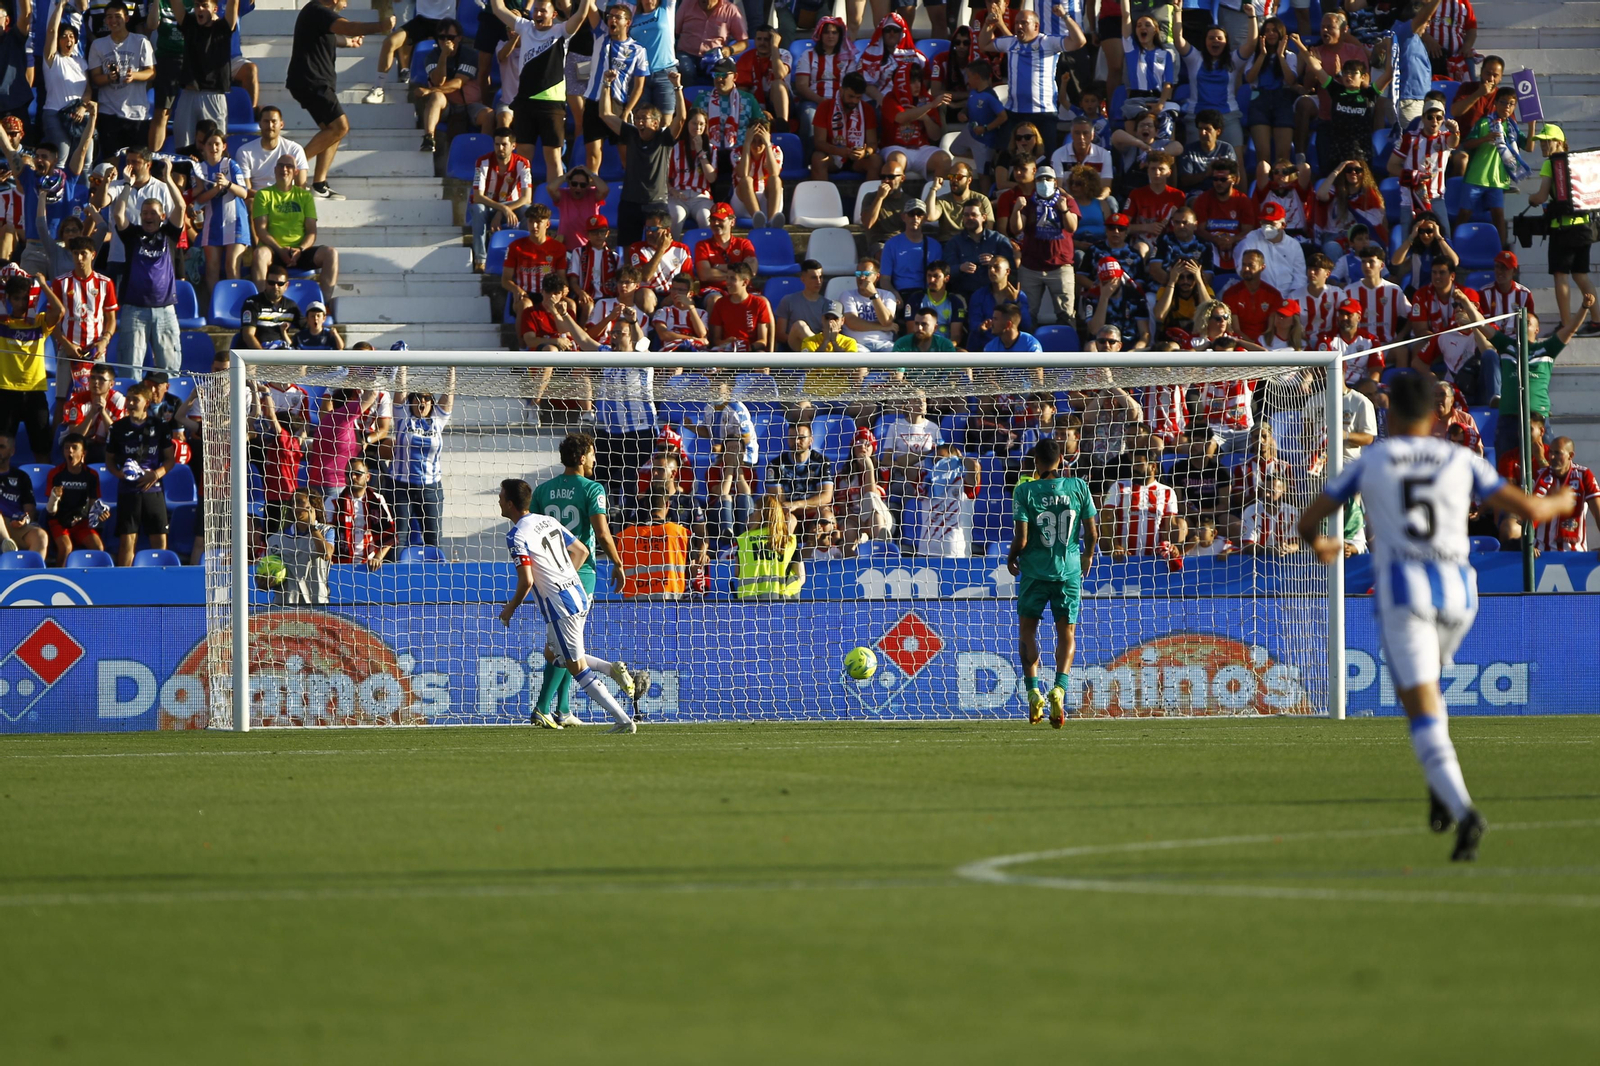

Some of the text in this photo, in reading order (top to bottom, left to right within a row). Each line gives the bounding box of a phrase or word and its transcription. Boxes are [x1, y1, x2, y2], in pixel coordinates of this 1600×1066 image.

[1336, 103, 1367, 116] betway
[550, 487, 575, 500] BABIĆ
[1401, 477, 1437, 541] 5
[541, 528, 571, 573] 17
[1036, 509, 1076, 548] 30
[97, 653, 450, 719] Domino's
[958, 645, 1528, 711] Domino's Piza
